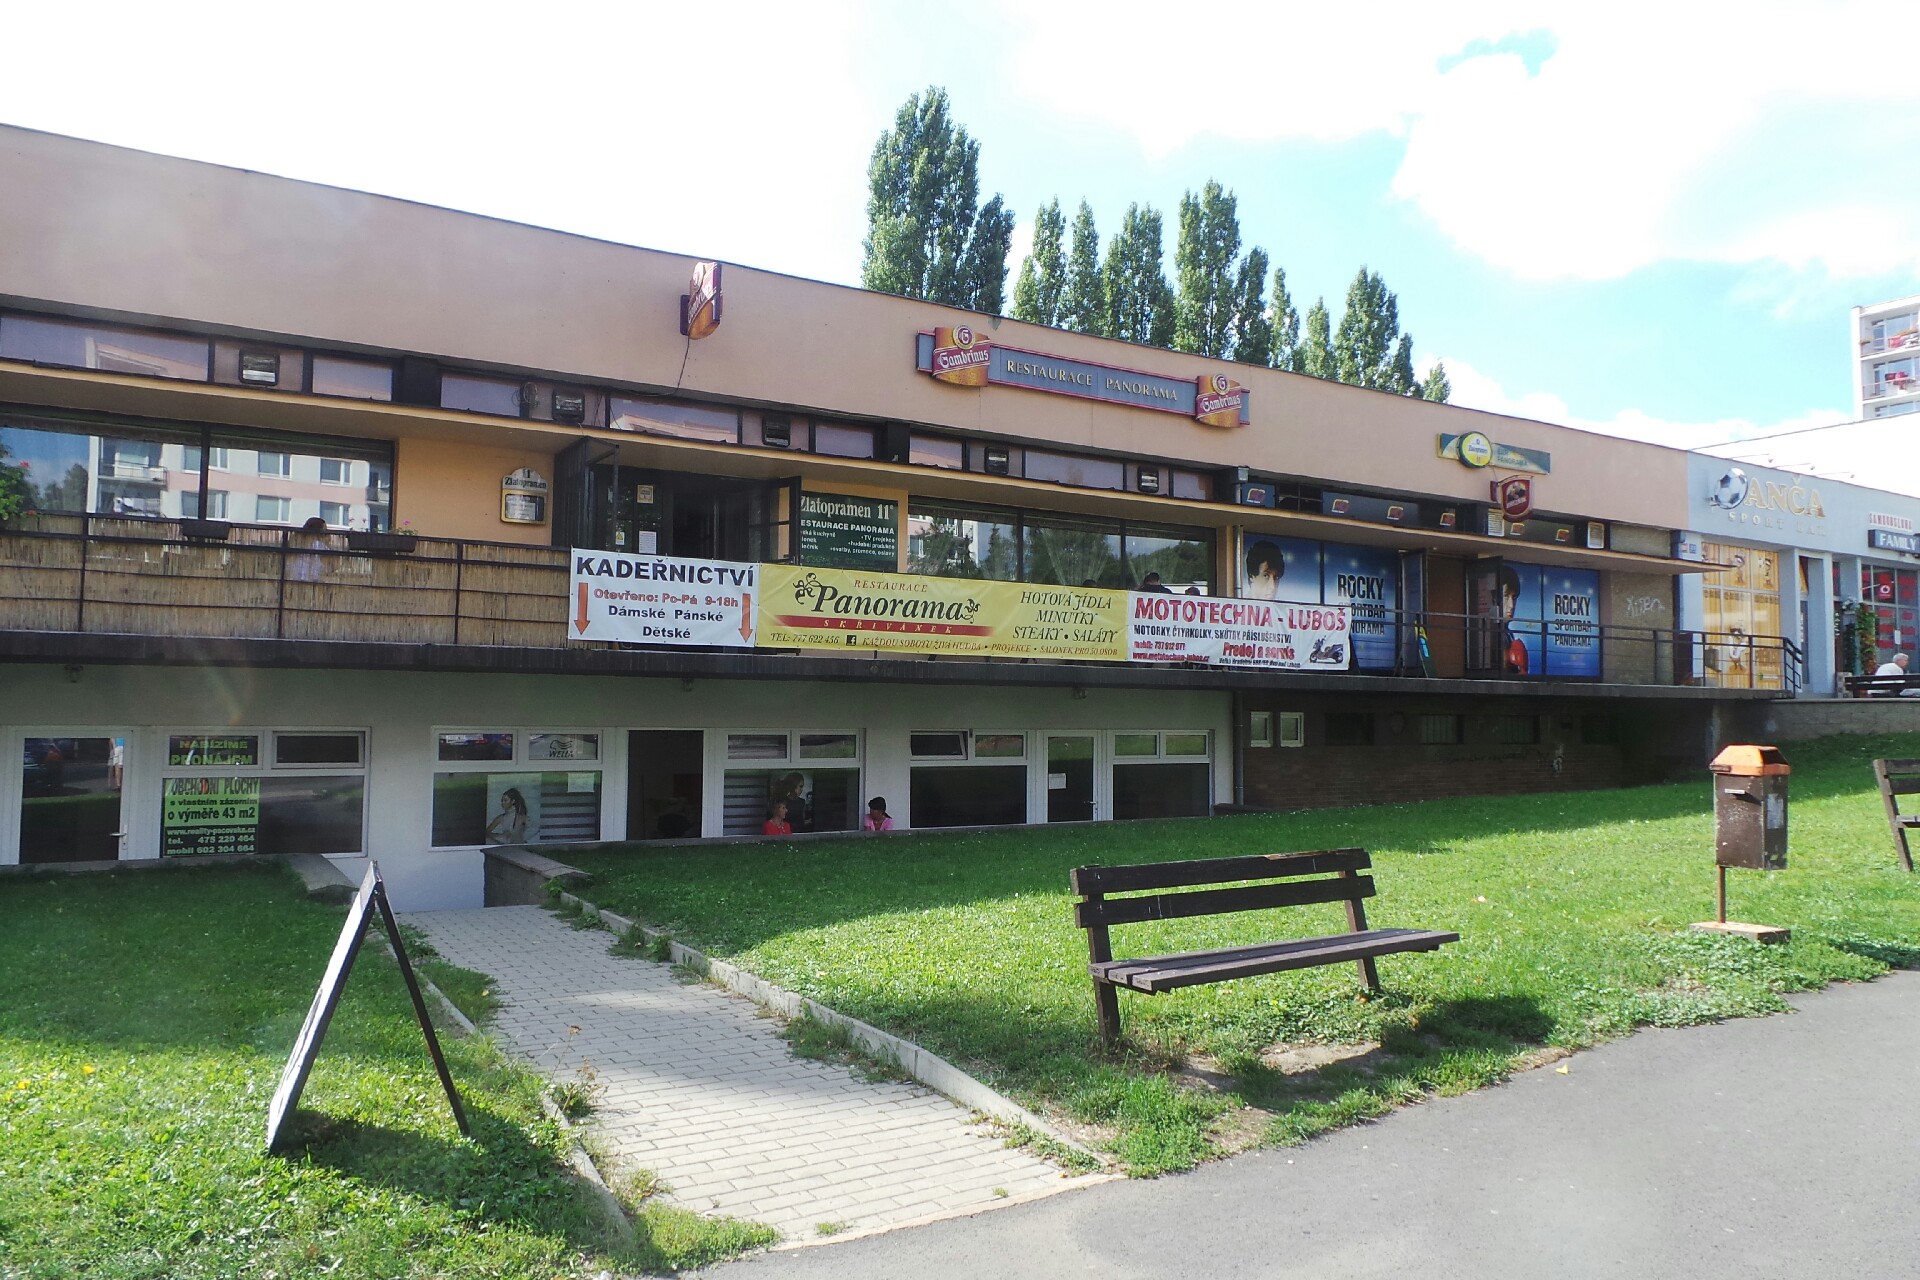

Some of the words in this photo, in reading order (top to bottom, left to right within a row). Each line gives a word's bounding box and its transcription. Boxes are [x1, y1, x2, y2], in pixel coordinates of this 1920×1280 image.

[937, 350, 989, 369] Gambrinus
[1007, 359, 1092, 386] RESTAURACE
[1106, 377, 1178, 401] PANORAMA
[1200, 394, 1241, 412] Gambrinus
[504, 476, 547, 489] Zlatopramen
[801, 495, 872, 518] Zlatopramen
[801, 520, 849, 531] ESTAURACE
[850, 524, 895, 535] PANORAMA
[1728, 511, 1785, 530] SPORT
[1880, 533, 1916, 551] FAMILY
[576, 556, 754, 587] KADEŘNICTVÍ
[854, 579, 929, 593] RESTAURACE
[1337, 574, 1384, 600] ROCKY
[593, 588, 659, 603] Otevřeno:
[662, 593, 698, 605] Po-Pá
[705, 595, 739, 607] 9-18h
[811, 585, 964, 622] Panorama
[1020, 591, 1073, 606] HOTOVÁ
[1073, 592, 1112, 611] JÍDLA
[1554, 594, 1591, 616] ROCKY
[608, 605, 666, 619] Dámské
[674, 609, 724, 622] Pánské
[1035, 609, 1099, 626] MINUTKY
[1134, 597, 1273, 628] MOTOTECHNA
[1288, 607, 1347, 631] LUBOŠ
[1351, 603, 1386, 619] ORTBAR
[642, 626, 691, 639] Dětské
[1351, 621, 1385, 635] NORAMA
[1554, 618, 1592, 633] SPORTBAR
[771, 632, 791, 642] TEL:
[793, 633, 807, 643] 777
[808, 634, 824, 644] 622
[825, 635, 840, 645] 456
[1012, 626, 1064, 641] STEAKY
[1072, 628, 1119, 643] SALÁTY
[1554, 635, 1592, 648] PANORAMA
[862, 637, 898, 647] KAŽDOU
[899, 639, 933, 649] SOBOTU
[933, 639, 951, 650] ŽIVÁ
[952, 641, 981, 651] HUDBA
[991, 643, 1031, 653] PROJEKCE
[224, 778, 258, 795] PLOCHY
[167, 811, 175, 820] o
[178, 807, 220, 823] výměře
[222, 807, 236, 819] 43
[238, 806, 256, 819] m2
[167, 837, 184, 845] tel.
[197, 836, 216, 844] 475
[218, 835, 235, 843] 220
[167, 846, 194, 855] mobil
[196, 846, 215, 854] 602
[217, 845, 235, 853] 304
